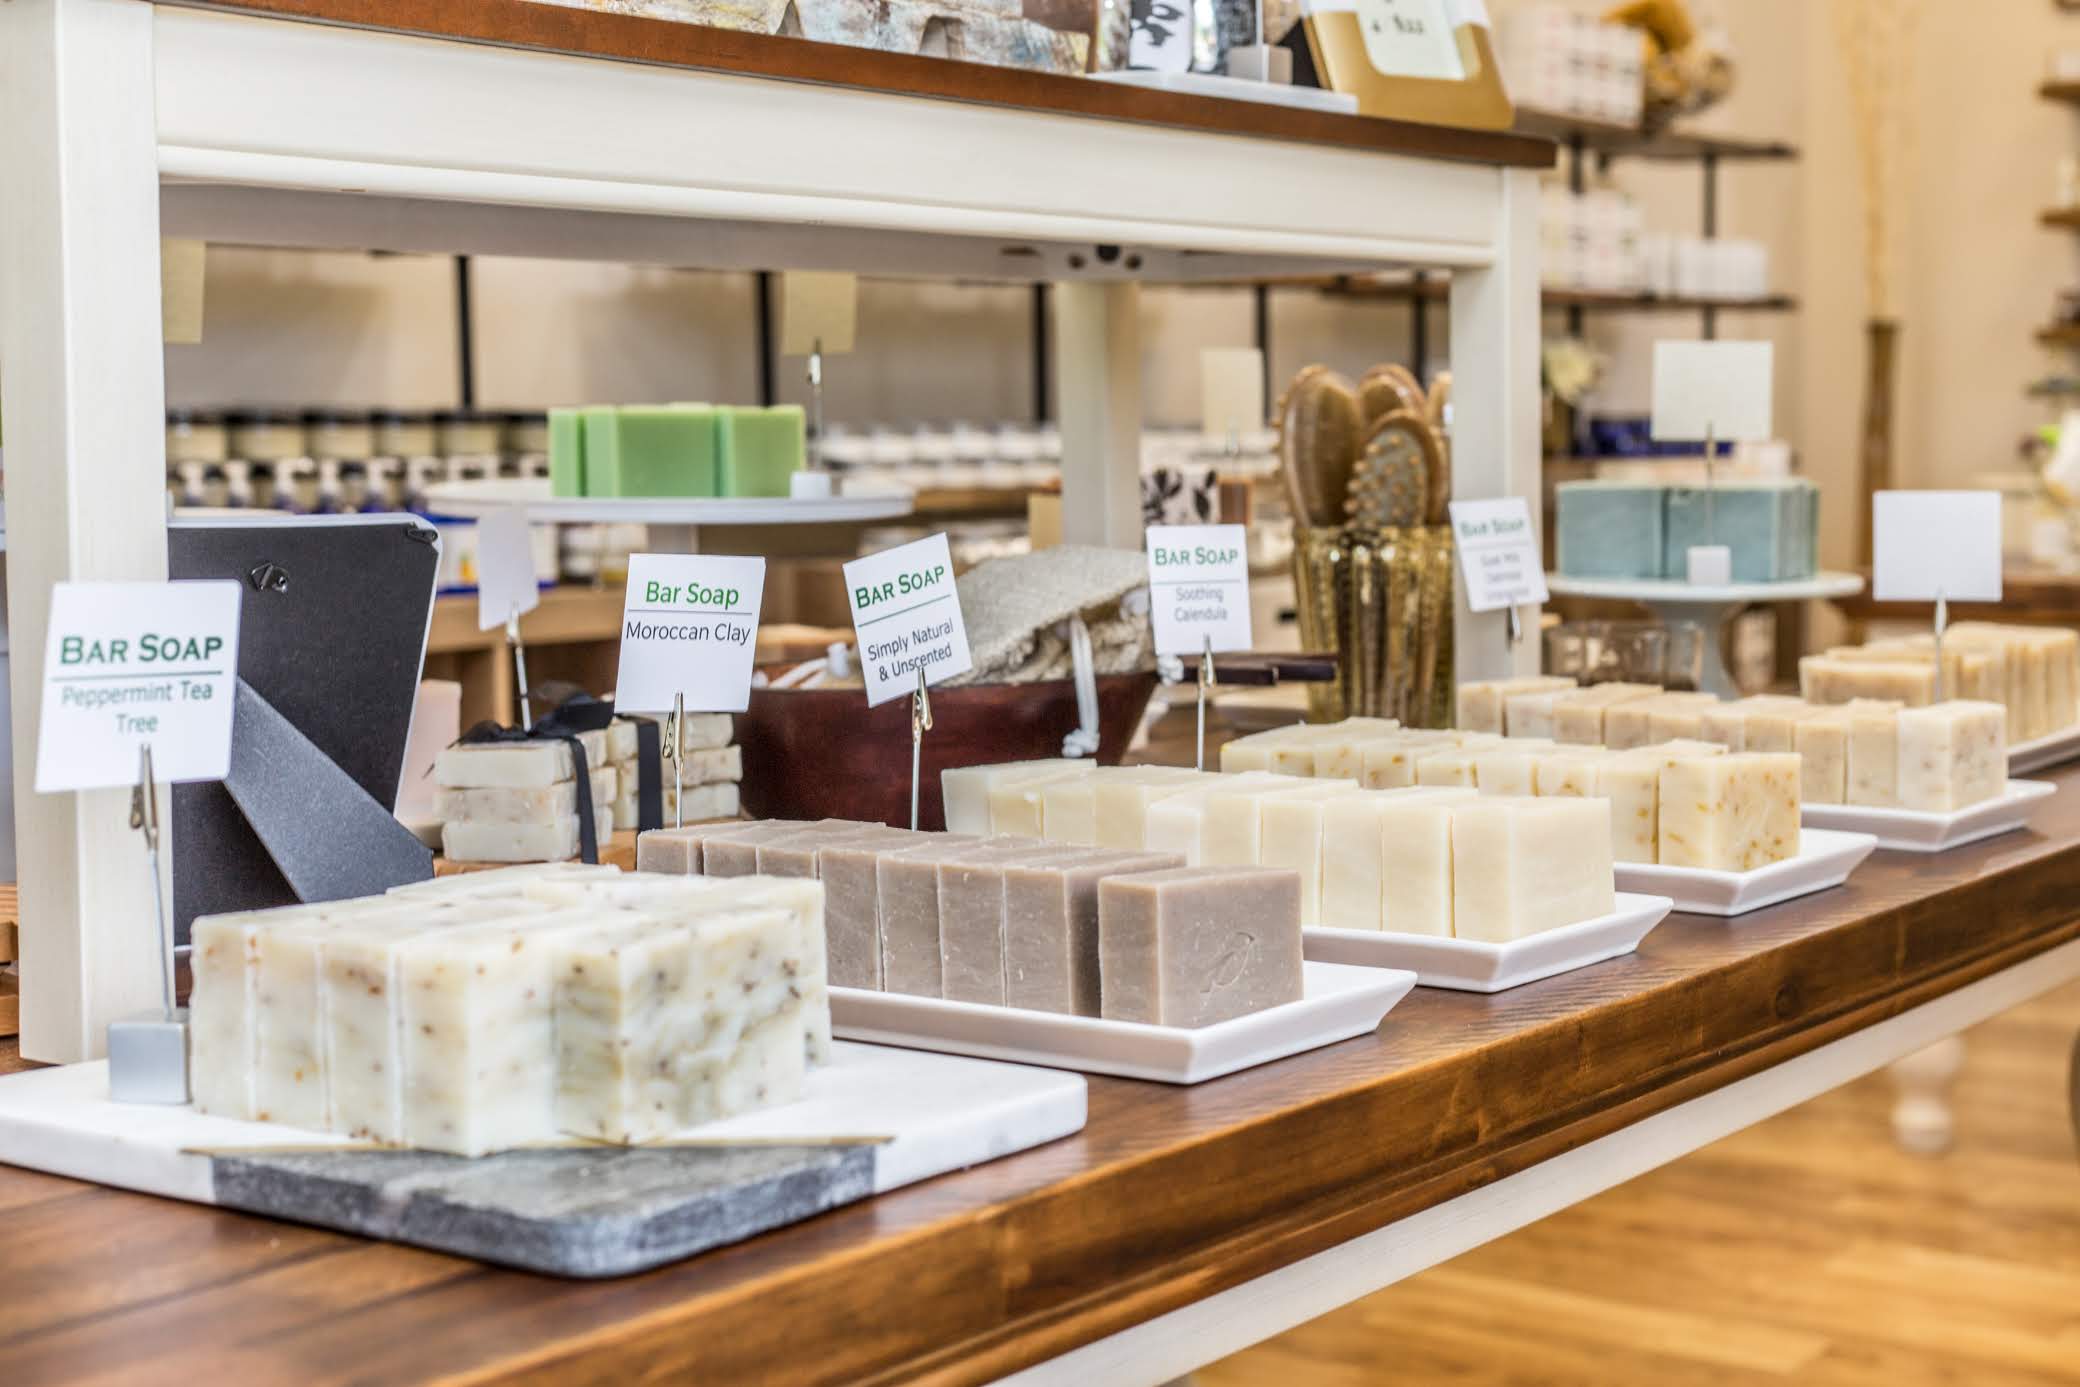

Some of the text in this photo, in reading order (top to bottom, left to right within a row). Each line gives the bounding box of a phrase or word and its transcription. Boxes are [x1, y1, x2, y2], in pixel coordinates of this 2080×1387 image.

[1154, 546, 1239, 565] BAR SOAP
[646, 580, 739, 610] Bar Soap
[856, 566, 945, 609] BAR SOAP
[626, 621, 751, 646] Moroccan Clay
[867, 617, 954, 662] Simply Natural
[60, 633, 223, 665] BAR SOAP
[879, 643, 953, 682] & Unscented
[61, 680, 213, 708] Peppermint Tea
[115, 713, 159, 734] Tree
